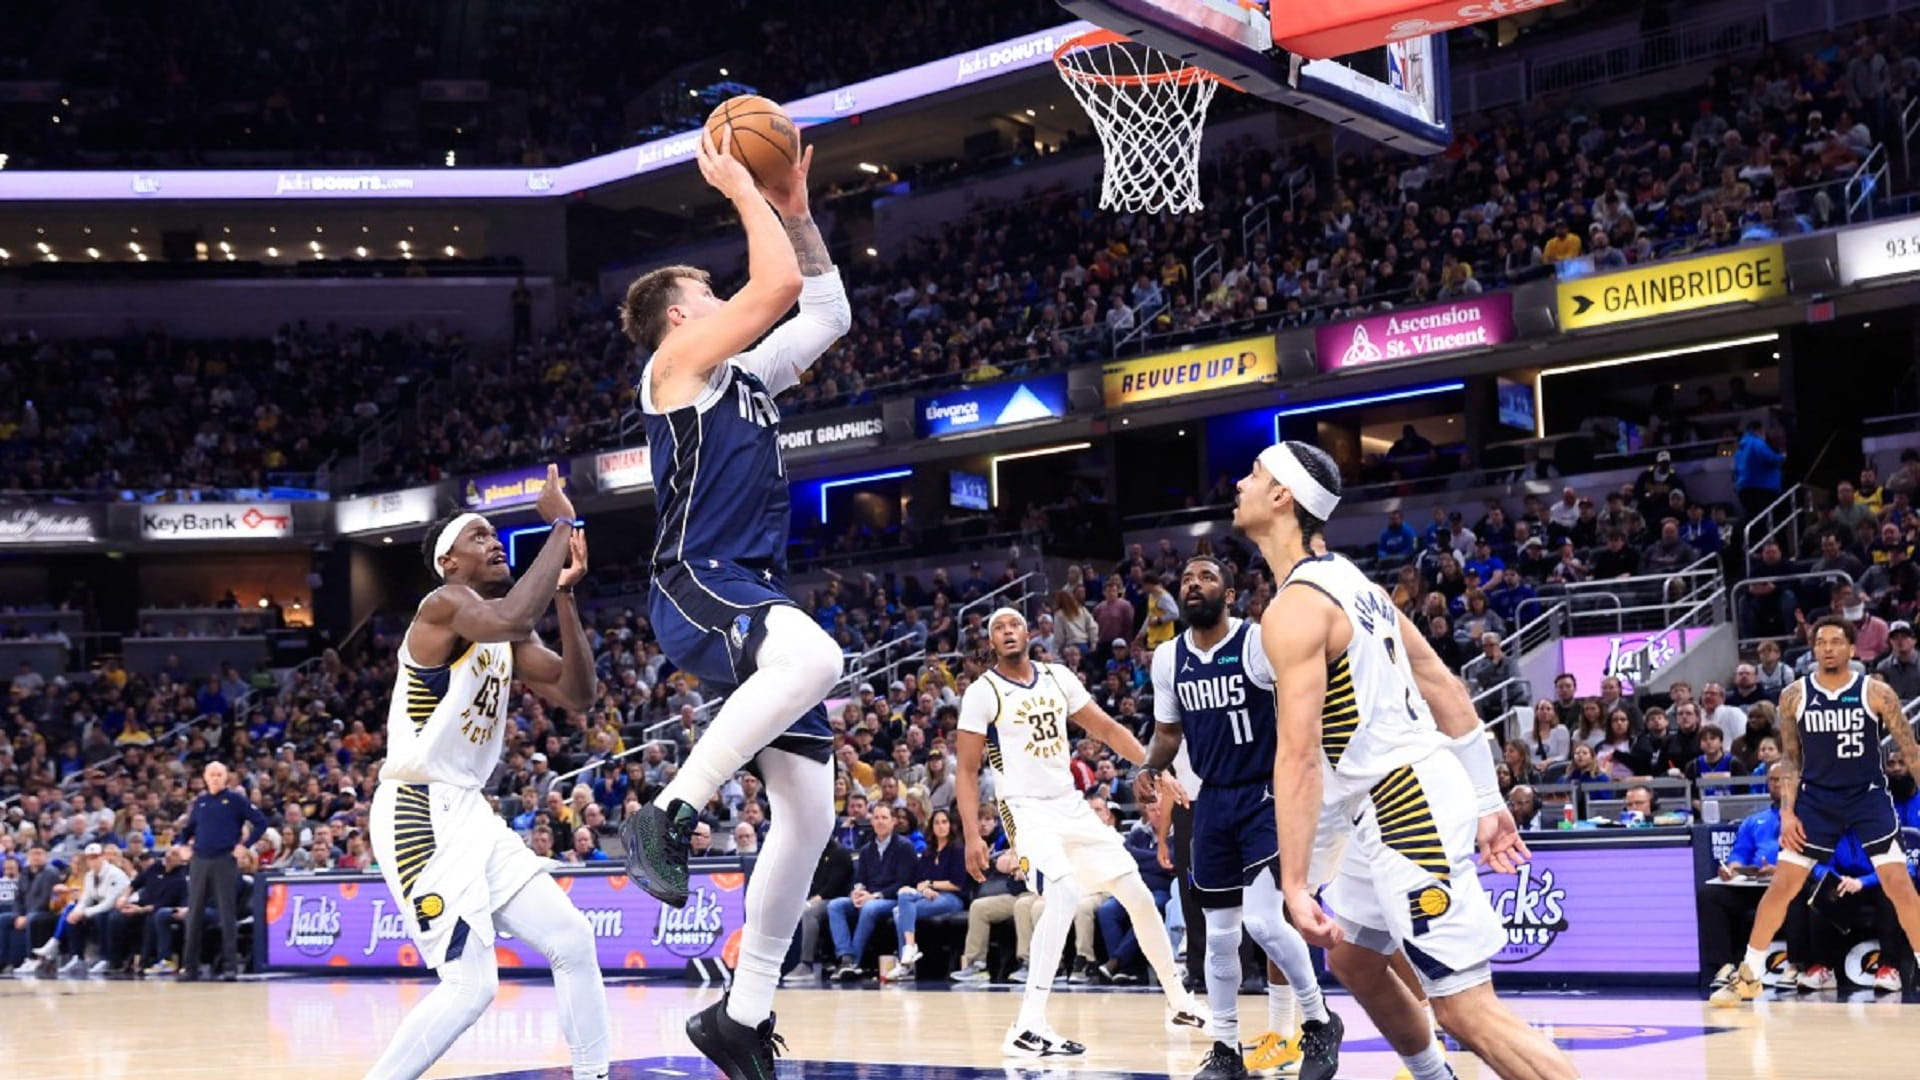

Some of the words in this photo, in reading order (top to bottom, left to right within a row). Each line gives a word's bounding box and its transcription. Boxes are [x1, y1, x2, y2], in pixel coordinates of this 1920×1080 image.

[1603, 257, 1773, 313] GAINBRIDGE
[1386, 305, 1482, 337] Ascension
[1385, 340, 1411, 360] St.
[1410, 325, 1487, 355] Vincent
[1121, 362, 1201, 394] REVVED
[1206, 356, 1235, 379] UP
[925, 400, 979, 421] Elevance
[816, 417, 884, 444] GRAPHICS
[600, 450, 644, 474] INDIANA
[143, 513, 236, 534] KeyBank
[473, 674, 500, 718] 43
[1028, 711, 1059, 742] 33
[1226, 708, 1254, 745] 11
[1836, 731, 1865, 759] 25
[285, 895, 342, 948] Jack's
[651, 887, 724, 947] Jack's
[665, 931, 715, 945] DONUTS
[1509, 927, 1550, 945] UTS
